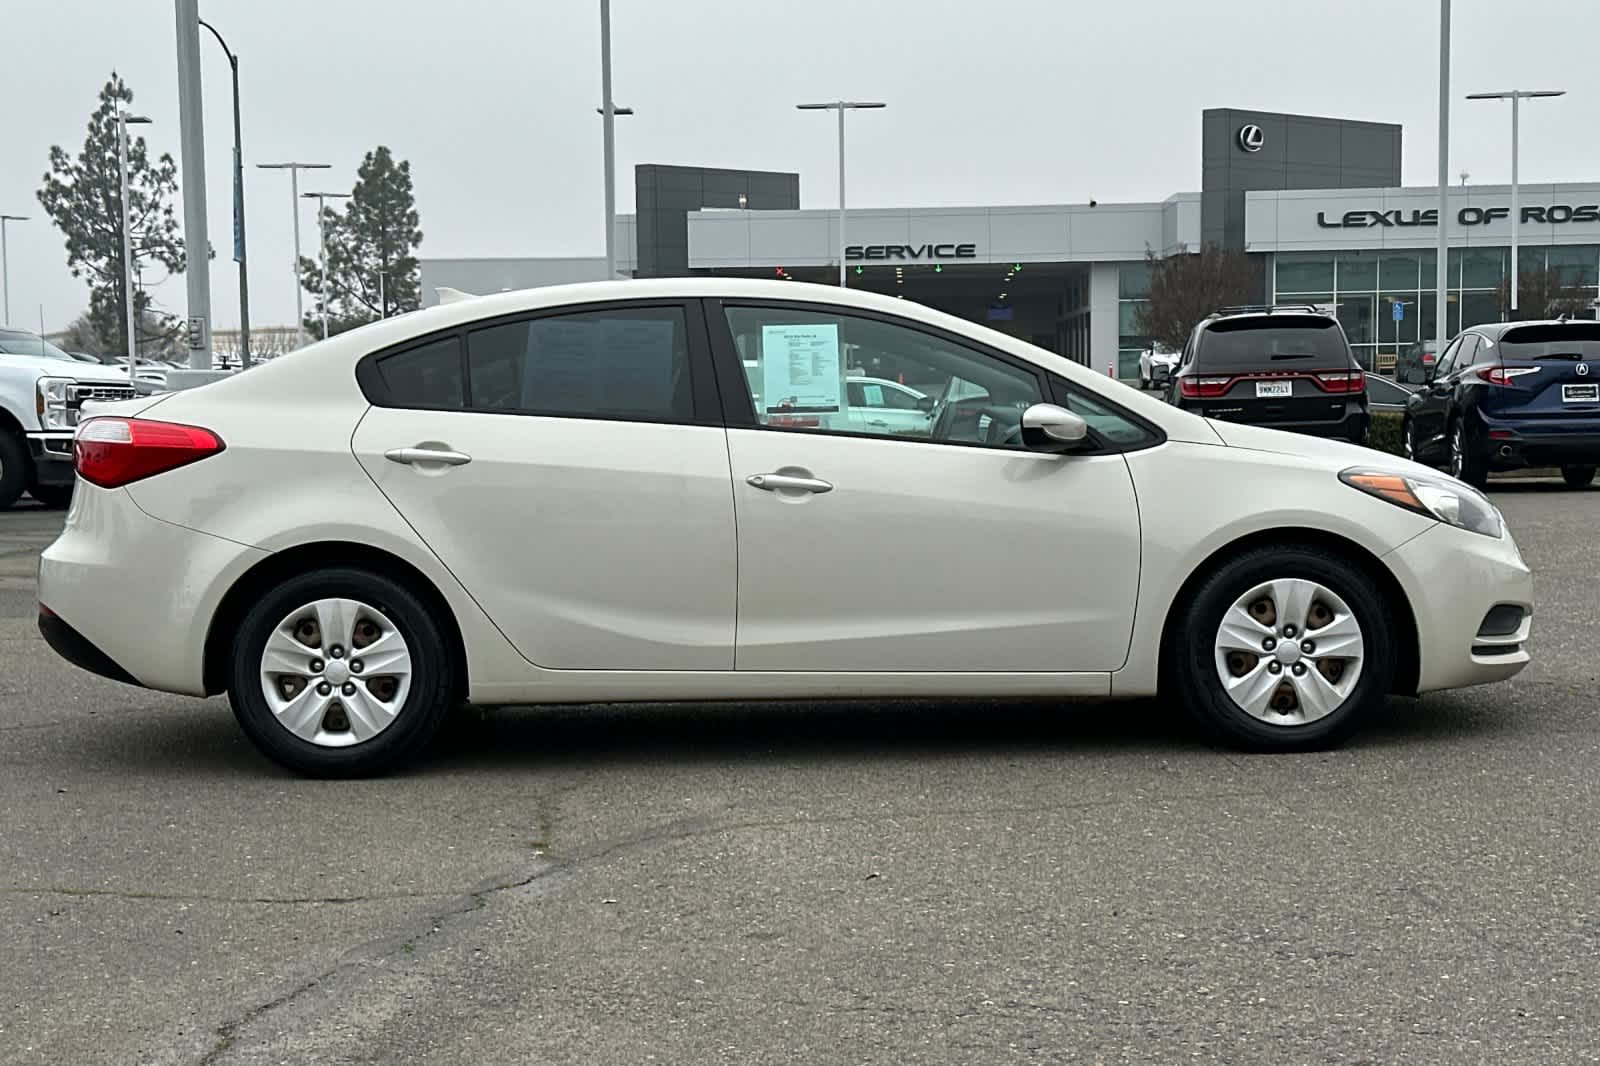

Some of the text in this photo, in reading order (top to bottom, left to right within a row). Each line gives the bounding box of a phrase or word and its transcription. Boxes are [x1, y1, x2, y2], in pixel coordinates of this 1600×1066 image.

[1317, 205, 1600, 228] LEXUS OF ROS
[845, 243, 977, 260] SERVICE
